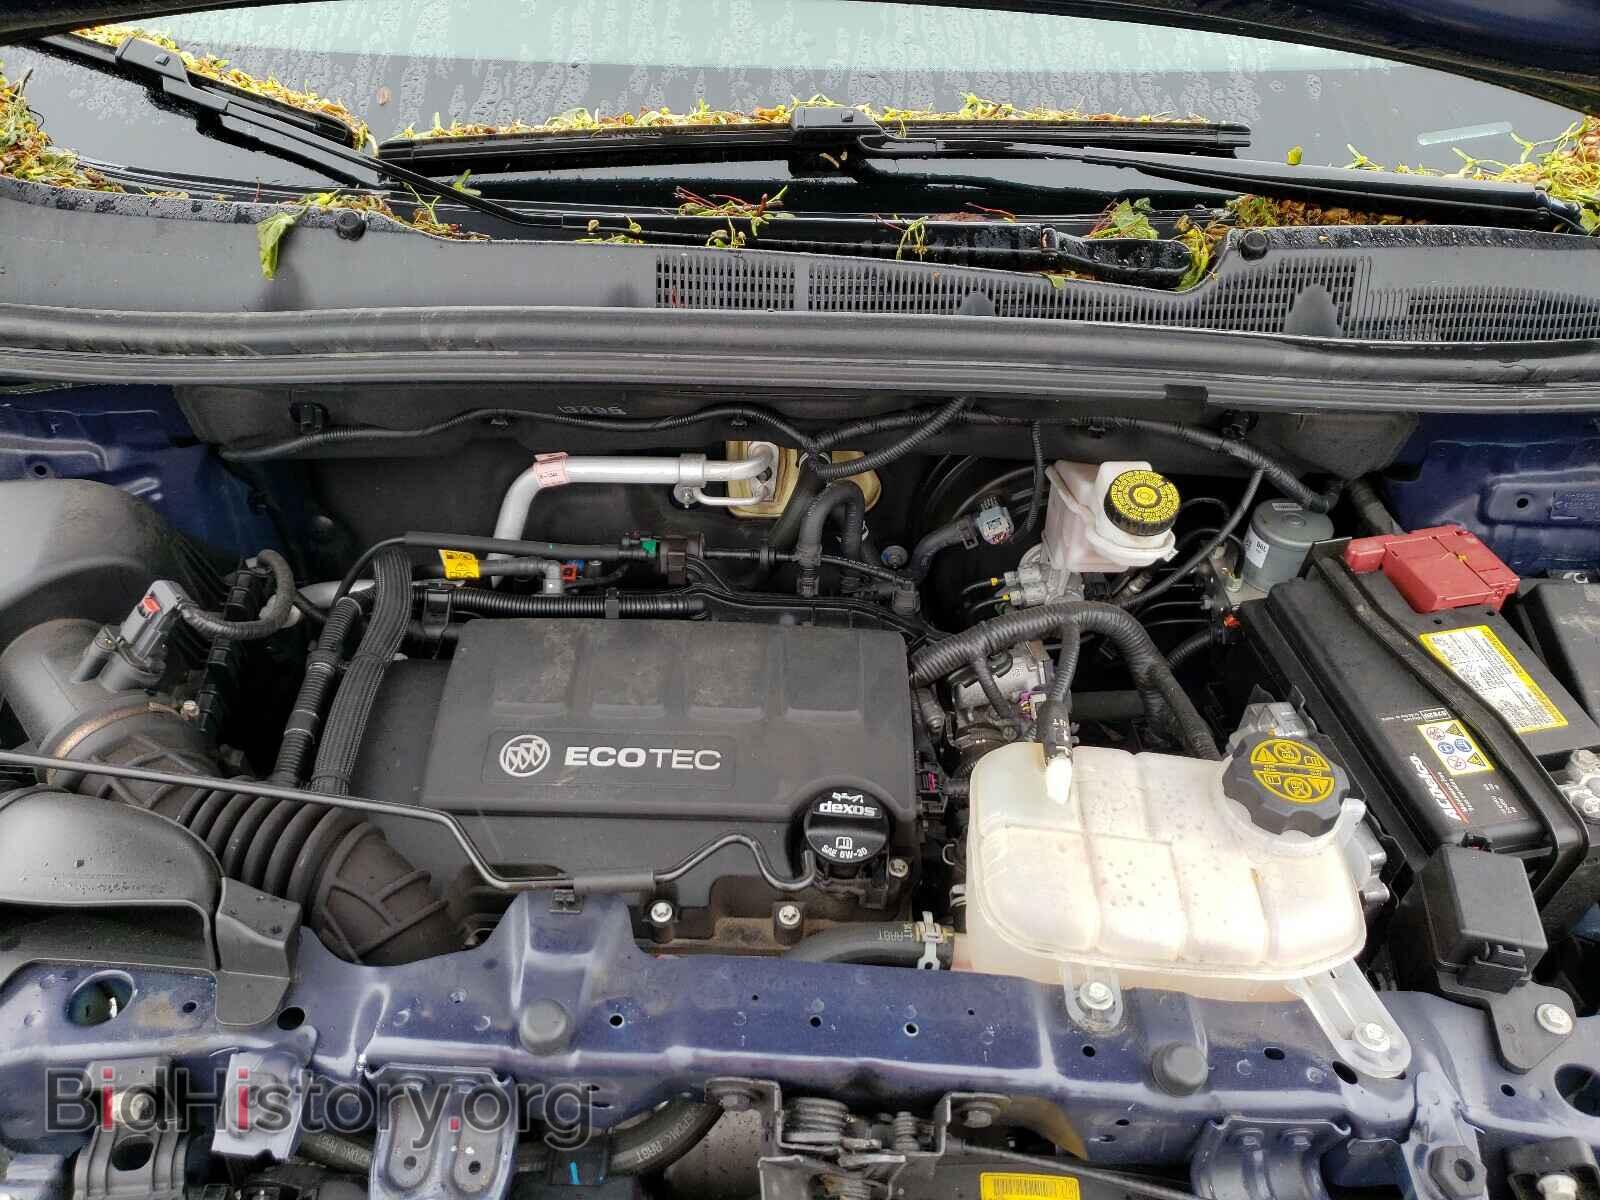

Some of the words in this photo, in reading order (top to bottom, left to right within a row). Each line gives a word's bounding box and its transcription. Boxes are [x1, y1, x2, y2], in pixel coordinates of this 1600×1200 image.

[564, 746, 722, 771] ECOTEC
[819, 800, 878, 817] dexos
[821, 844, 838, 857] SAE
